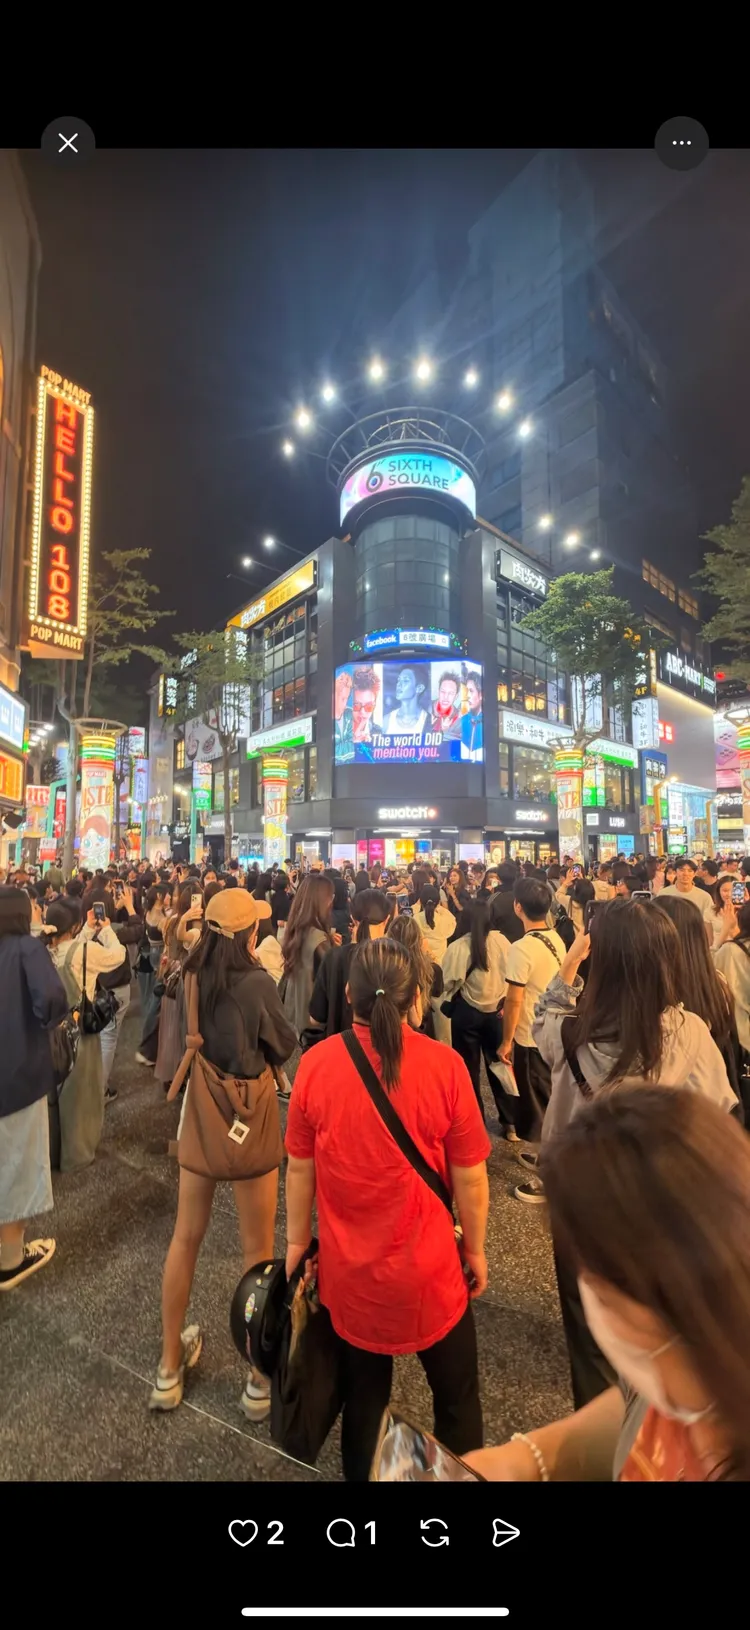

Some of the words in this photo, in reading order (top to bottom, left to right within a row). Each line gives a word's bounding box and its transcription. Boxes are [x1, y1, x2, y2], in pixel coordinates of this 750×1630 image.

[41, 365, 62, 385] POP
[63, 379, 91, 404] MART
[52, 398, 77, 533] HELLO
[388, 459, 432, 472] SIXTH
[388, 473, 449, 490] SQUARE
[48, 545, 70, 619] 108
[31, 624, 52, 641] POP
[54, 631, 82, 650] MART
[366, 635, 397, 648] facebook
[372, 734, 391, 747] The
[393, 732, 422, 747] world
[424, 732, 442, 746] DID
[373, 746, 416, 759] mention
[418, 747, 440, 760] you.
[378, 806, 428, 819] swatch
[516, 810, 543, 821] swatch
